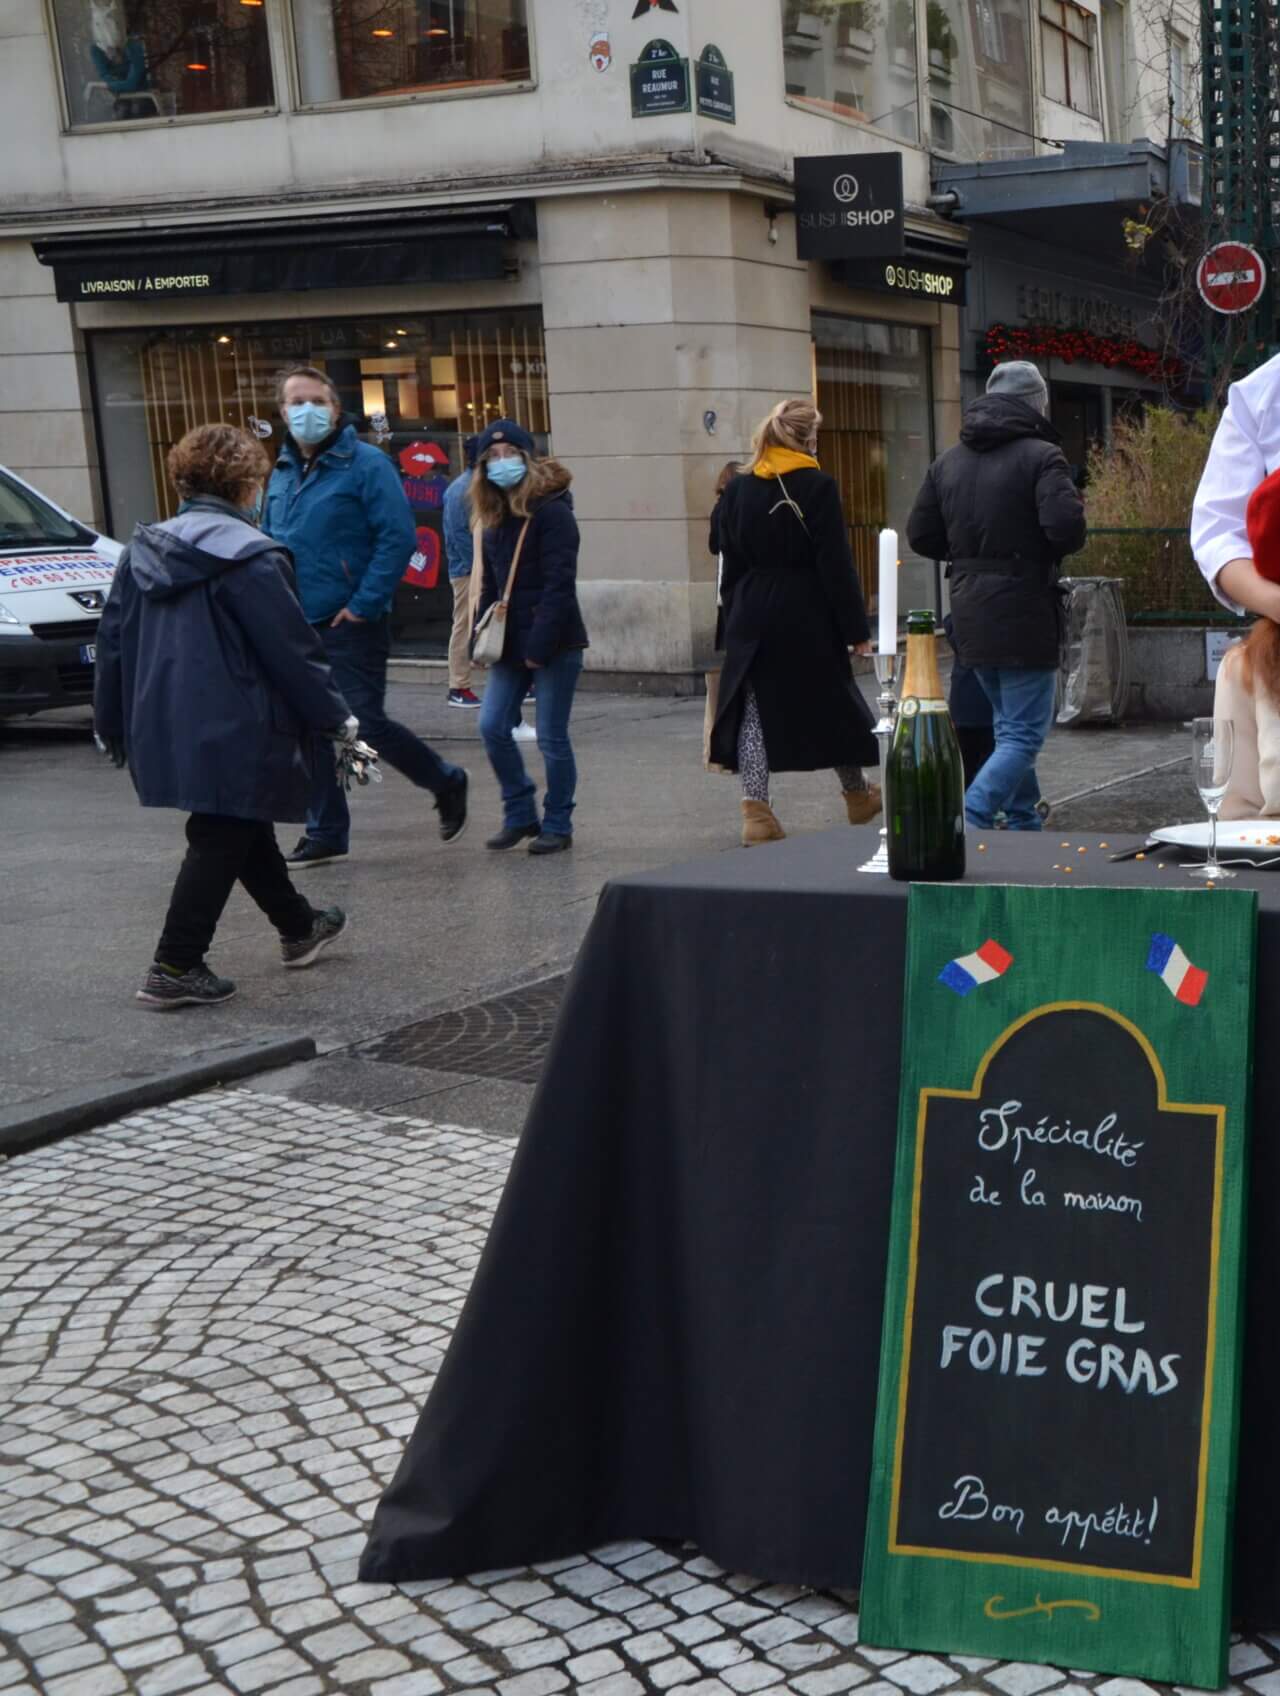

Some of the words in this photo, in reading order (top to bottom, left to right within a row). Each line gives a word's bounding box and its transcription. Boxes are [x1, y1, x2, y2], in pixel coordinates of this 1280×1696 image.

[652, 68, 667, 79] RUE
[80, 279, 135, 294] LIVRAISON
[154, 274, 210, 290] EMPORTER
[978, 1100, 1145, 1167] Spécialité
[969, 1175, 1003, 1206] de
[1020, 1168, 1047, 1206] la
[1064, 1190, 1145, 1223] maison
[975, 1273, 1146, 1334] CRUEL
[940, 1325, 1048, 1377] FOIE
[1065, 1337, 1182, 1396] GRAS
[938, 1474, 1025, 1536] Bon
[1045, 1496, 1159, 1550] appétit!
